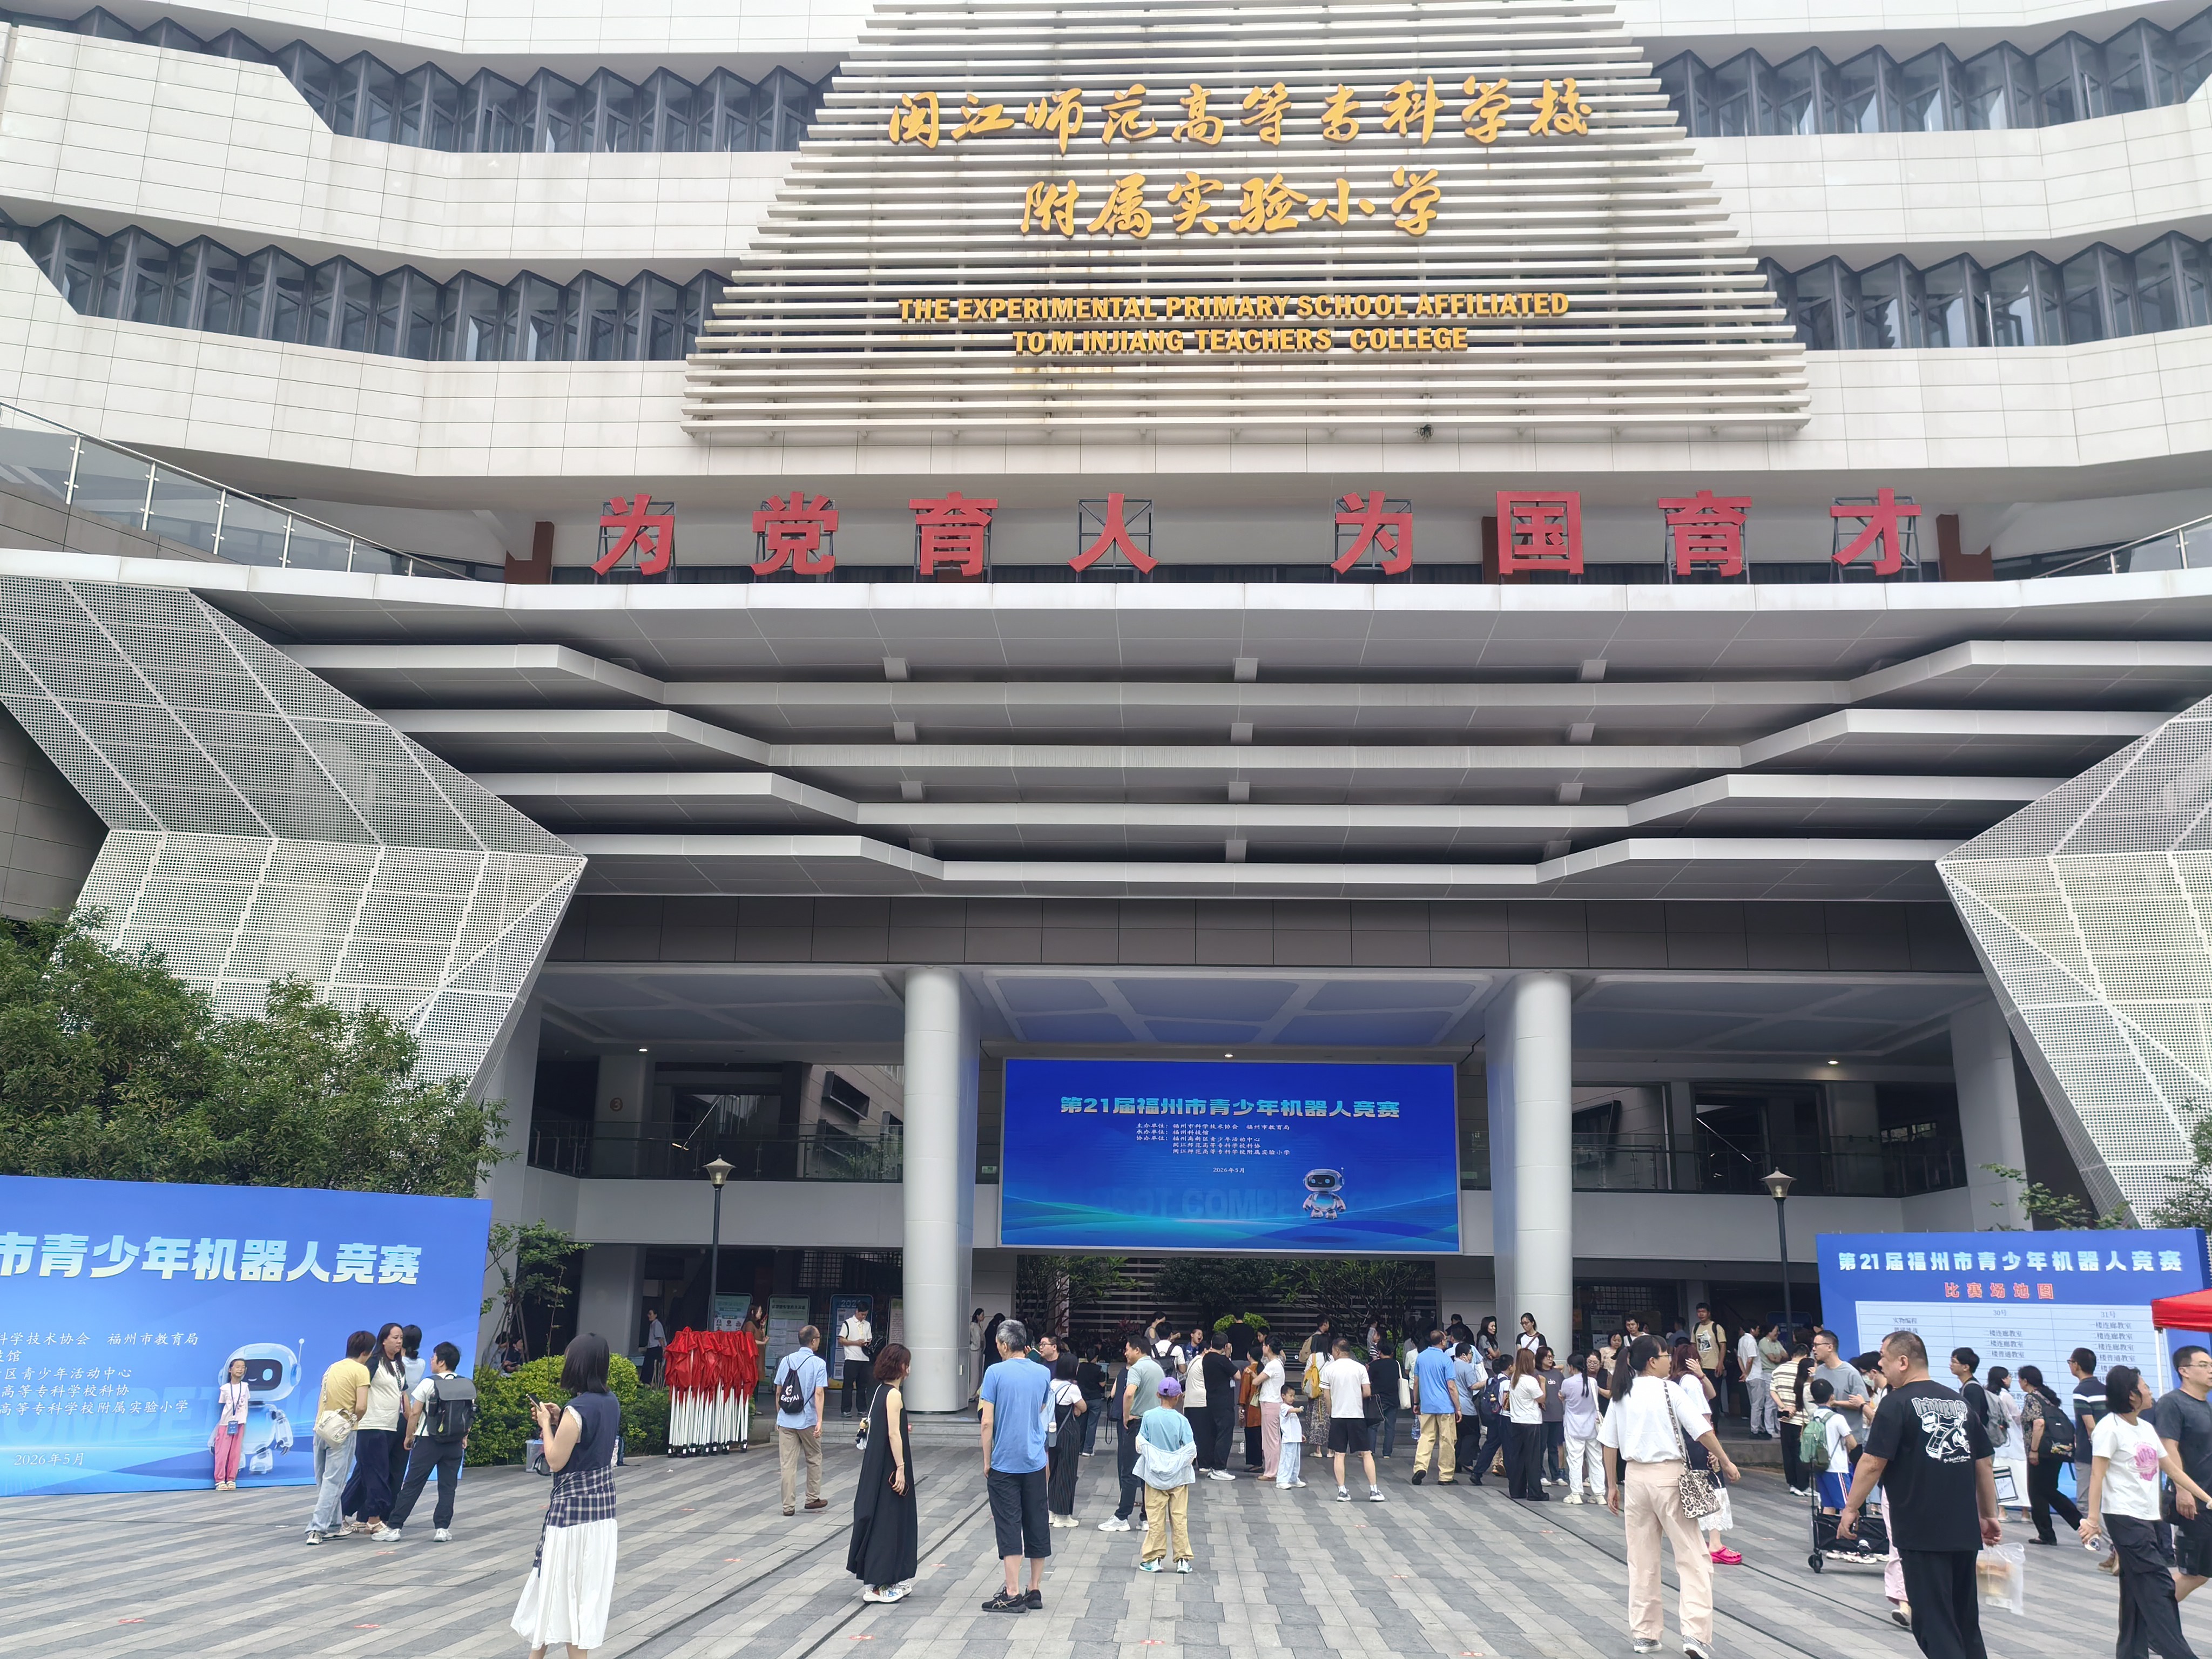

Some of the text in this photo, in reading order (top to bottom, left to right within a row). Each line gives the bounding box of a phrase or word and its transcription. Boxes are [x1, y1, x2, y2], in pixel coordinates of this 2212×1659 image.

[889, 76, 1593, 154] 闽江师范高等专科学校
[1021, 168, 1442, 239] 附属实验小学
[899, 293, 1569, 322] THE EXPERIMENTAL PRIMARY SCHOOL AFFILIATED
[1195, 329, 1332, 353] TEACHERS
[1351, 328, 1468, 352] COLLEGE
[592, 489, 1921, 577] 为党育人 为国育才
[1061, 1096, 1400, 1118] 第21届福州市青少年机器人竞赛
[0, 1232, 422, 1285] 市青少年机器人竞赛
[1839, 1251, 2183, 1272] 第21届福州市青少年机器人竞赛
[1944, 1282, 2054, 1300] 比赛场地图
[107, 1332, 198, 1346] 福州市教育局
[0, 1366, 132, 1380] 区青少年活动中心
[2, 1384, 130, 1398] 高等专科学校科协
[0, 1399, 188, 1415] 高等专科学校附属实验小学
[14, 1452, 84, 1467] 2026年5月
